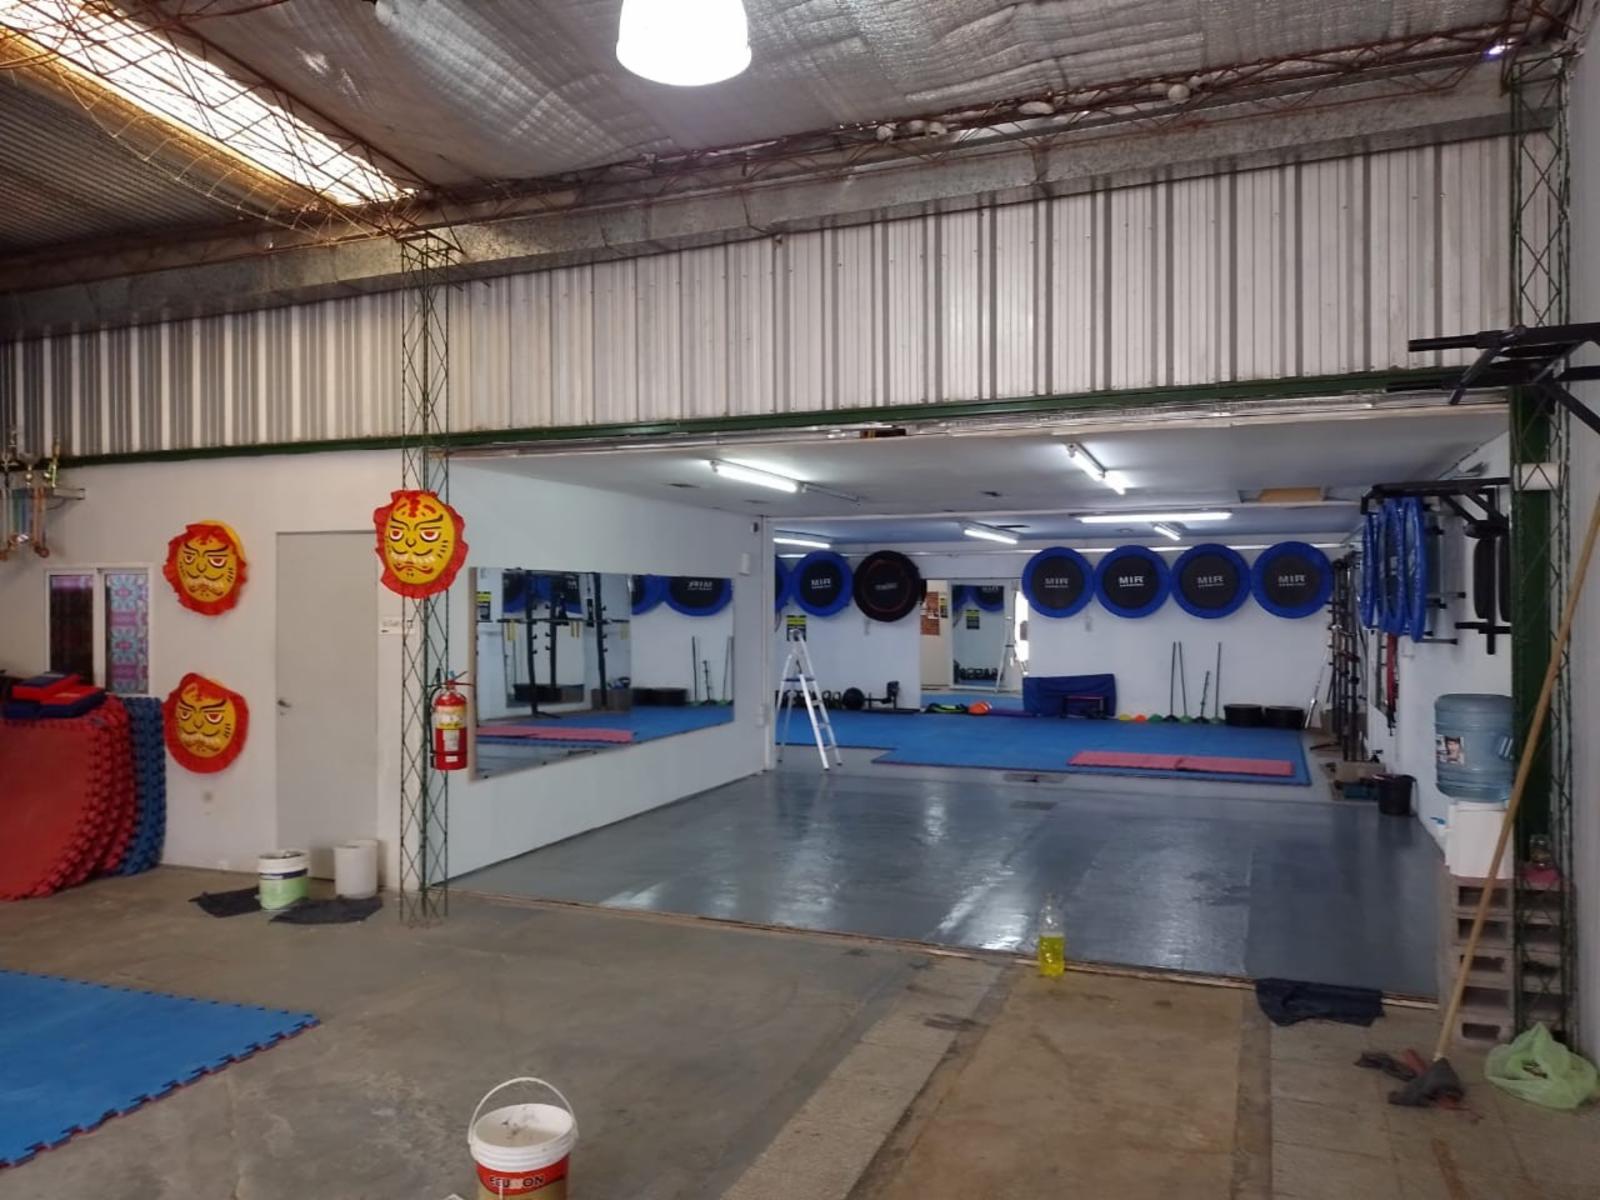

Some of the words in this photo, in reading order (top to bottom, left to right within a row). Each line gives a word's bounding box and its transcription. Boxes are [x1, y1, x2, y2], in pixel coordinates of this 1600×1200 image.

[1045, 577, 1069, 585] MIR
[1119, 575, 1143, 584] MIR
[1198, 575, 1224, 584] MIR
[1278, 574, 1305, 583] MIR
